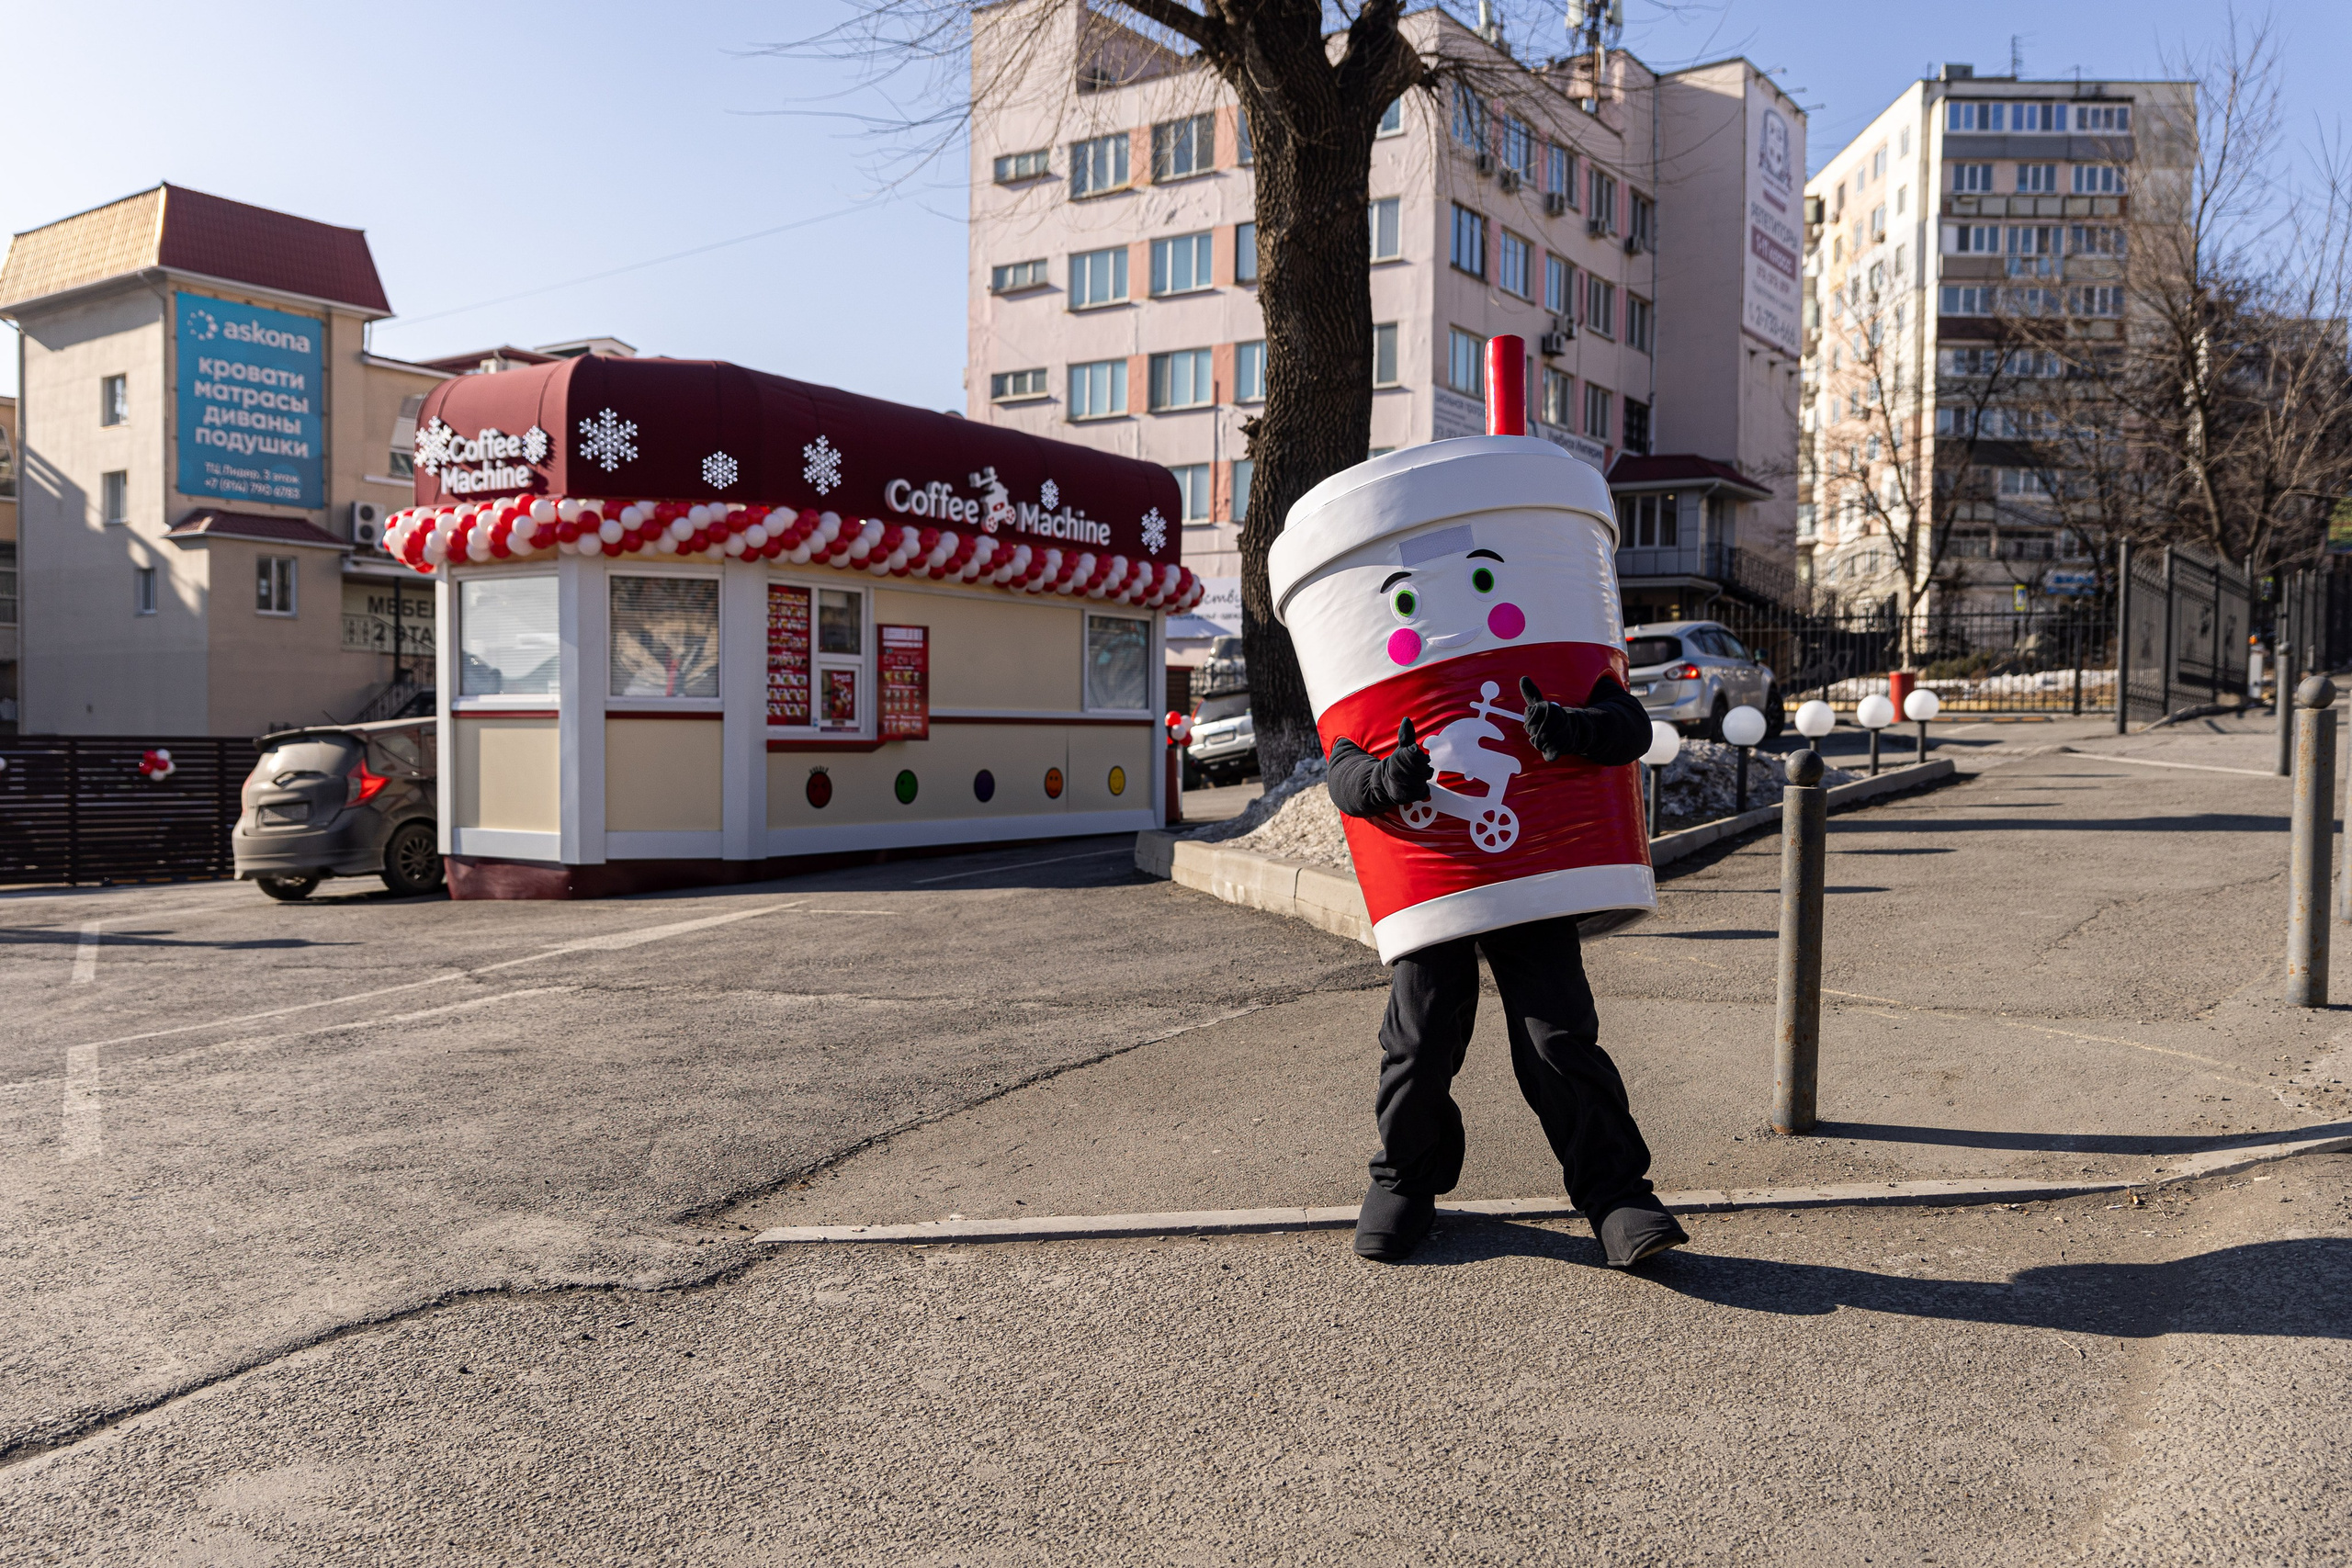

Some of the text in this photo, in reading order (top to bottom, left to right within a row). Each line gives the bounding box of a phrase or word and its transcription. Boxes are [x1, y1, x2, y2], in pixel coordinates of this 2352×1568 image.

[223, 320, 311, 354] askona
[198, 356, 305, 390] кровати
[194, 380, 310, 414] матрасы
[203, 405, 302, 435] диваны
[195, 427, 309, 458] подушки
[448, 427, 522, 464] Coffee
[440, 459, 531, 494] Machine
[885, 478, 1111, 546] Coffee Machine
[368, 595, 435, 619] МЕБЕ
